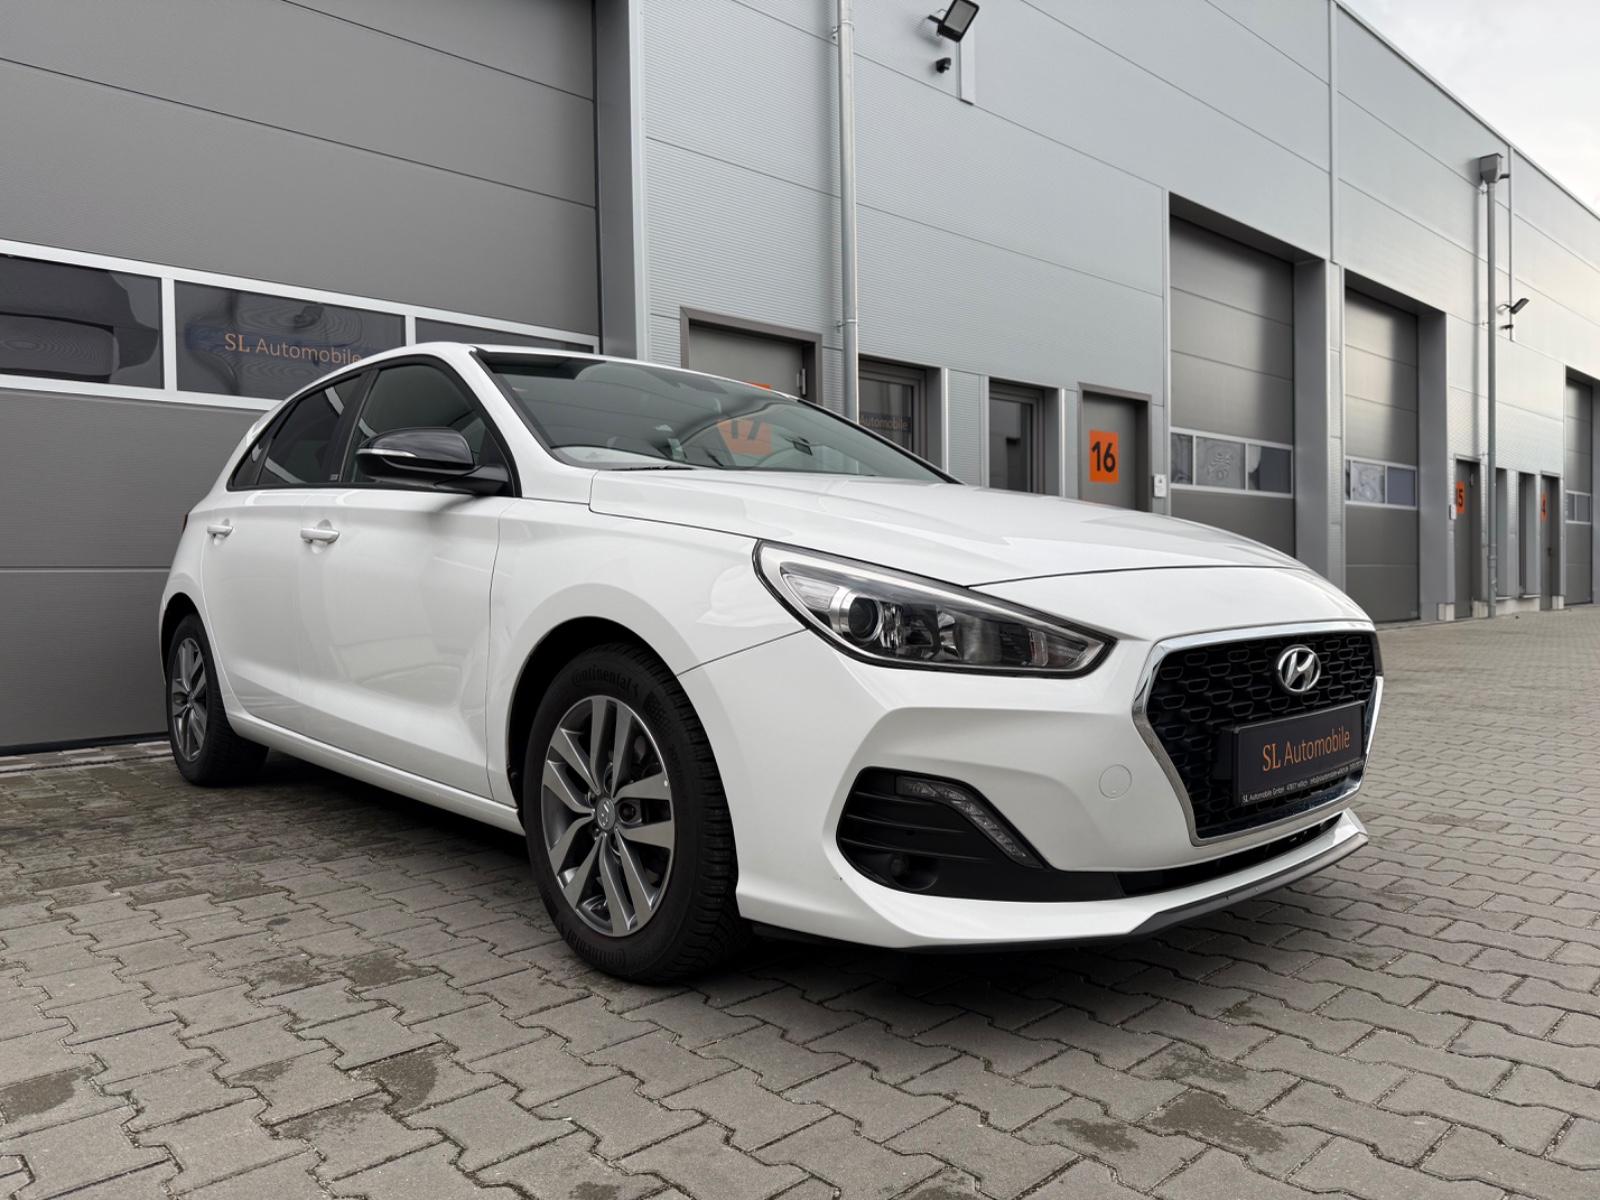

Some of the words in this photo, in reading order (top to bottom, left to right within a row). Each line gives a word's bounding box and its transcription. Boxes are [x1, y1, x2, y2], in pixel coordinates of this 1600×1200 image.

[224, 333, 250, 353] SL
[255, 338, 361, 365] Automobile
[1092, 441, 1116, 473] 16
[1262, 743, 1281, 772] SL
[1284, 726, 1351, 767] Automobile
